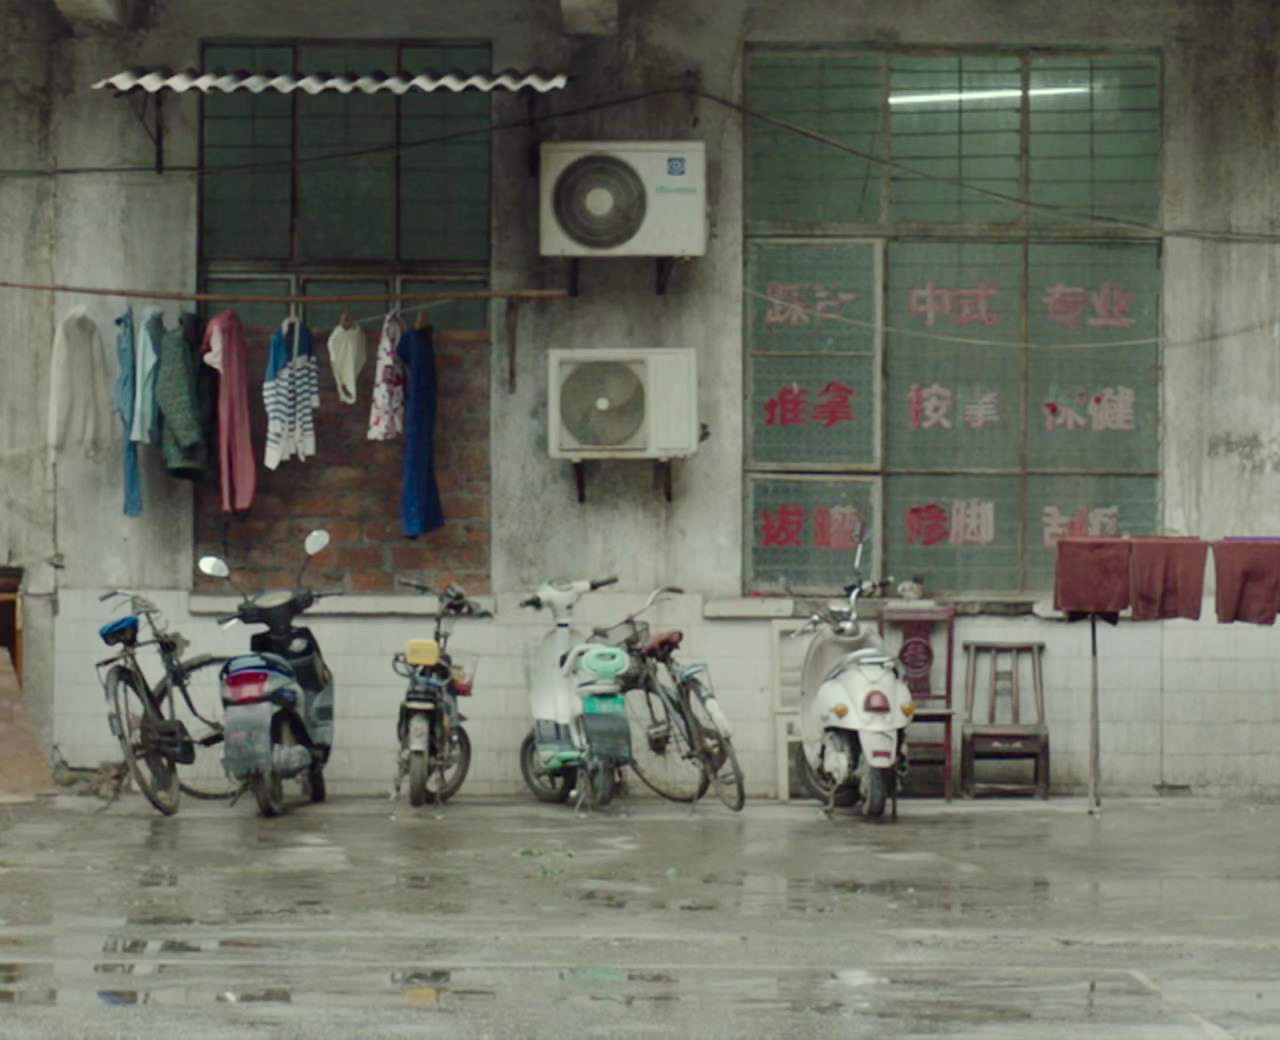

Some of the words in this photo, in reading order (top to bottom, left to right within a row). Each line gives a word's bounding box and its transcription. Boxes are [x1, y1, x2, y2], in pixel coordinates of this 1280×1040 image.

[909, 283, 999, 327] 中式
[1042, 283, 1136, 328] 专业
[762, 380, 856, 428] 推拿
